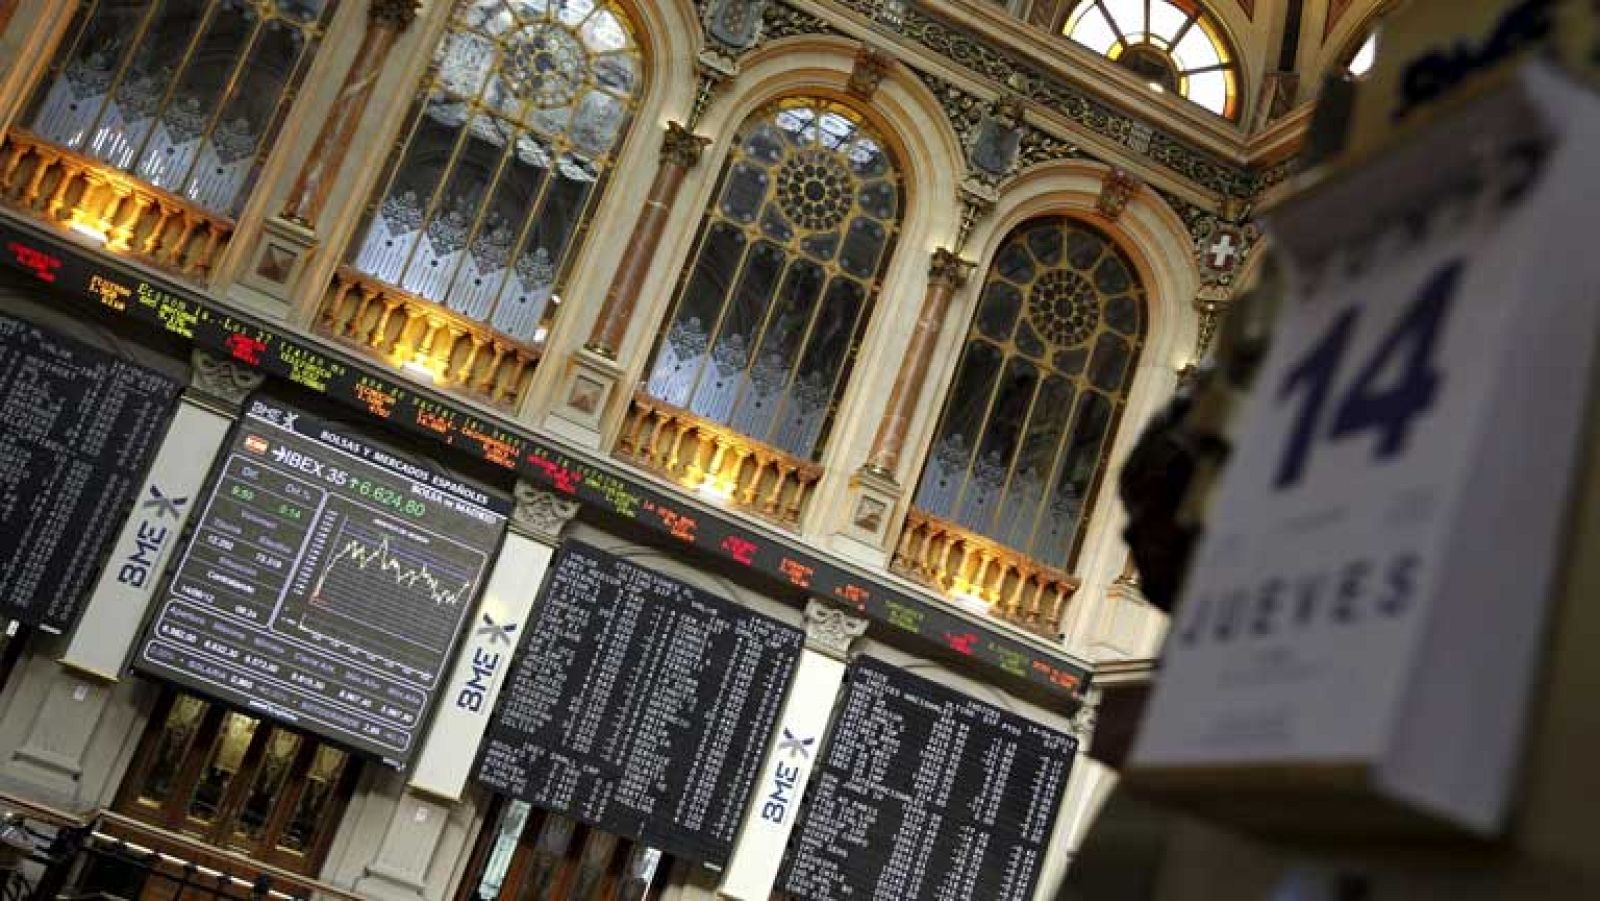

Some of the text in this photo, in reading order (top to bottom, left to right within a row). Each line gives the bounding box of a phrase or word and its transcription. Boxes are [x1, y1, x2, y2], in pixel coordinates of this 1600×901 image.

[1273, 256, 1468, 490] 14
[325, 468, 349, 486] 35
[374, 451, 430, 481] MERCADOS
[1180, 556, 1420, 646] JUEVES
